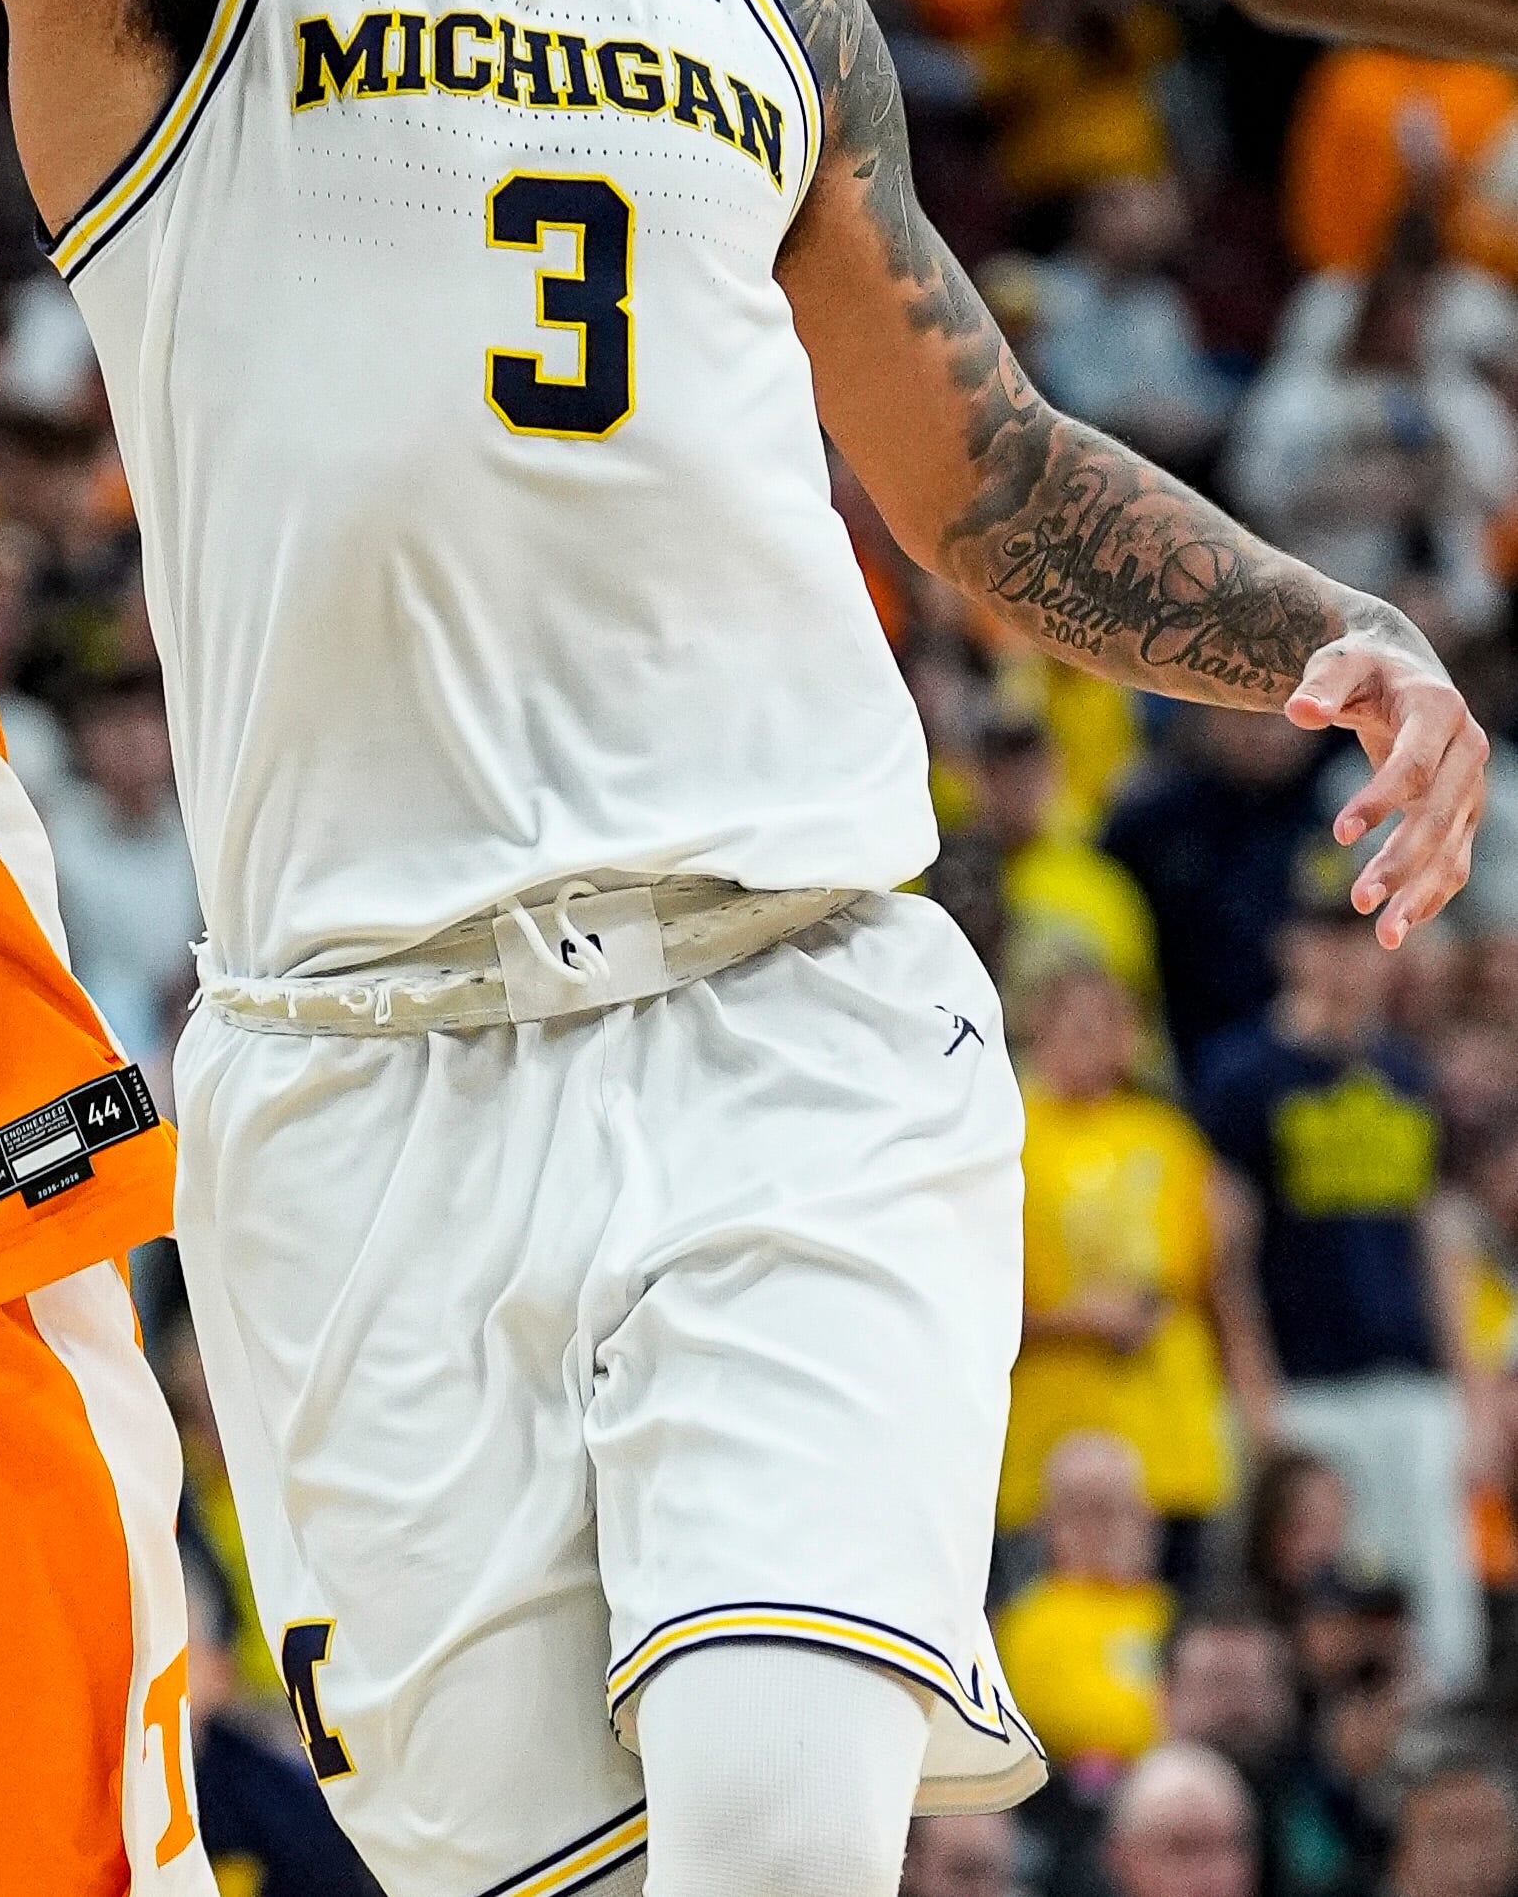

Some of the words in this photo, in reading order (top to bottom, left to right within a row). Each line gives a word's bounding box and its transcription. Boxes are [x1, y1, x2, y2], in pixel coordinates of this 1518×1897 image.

[291, 10, 786, 195] MICHIGAN
[485, 168, 636, 442] 3
[2, 1104, 66, 1144] ENGINEERED
[87, 1095, 122, 1127] 44
